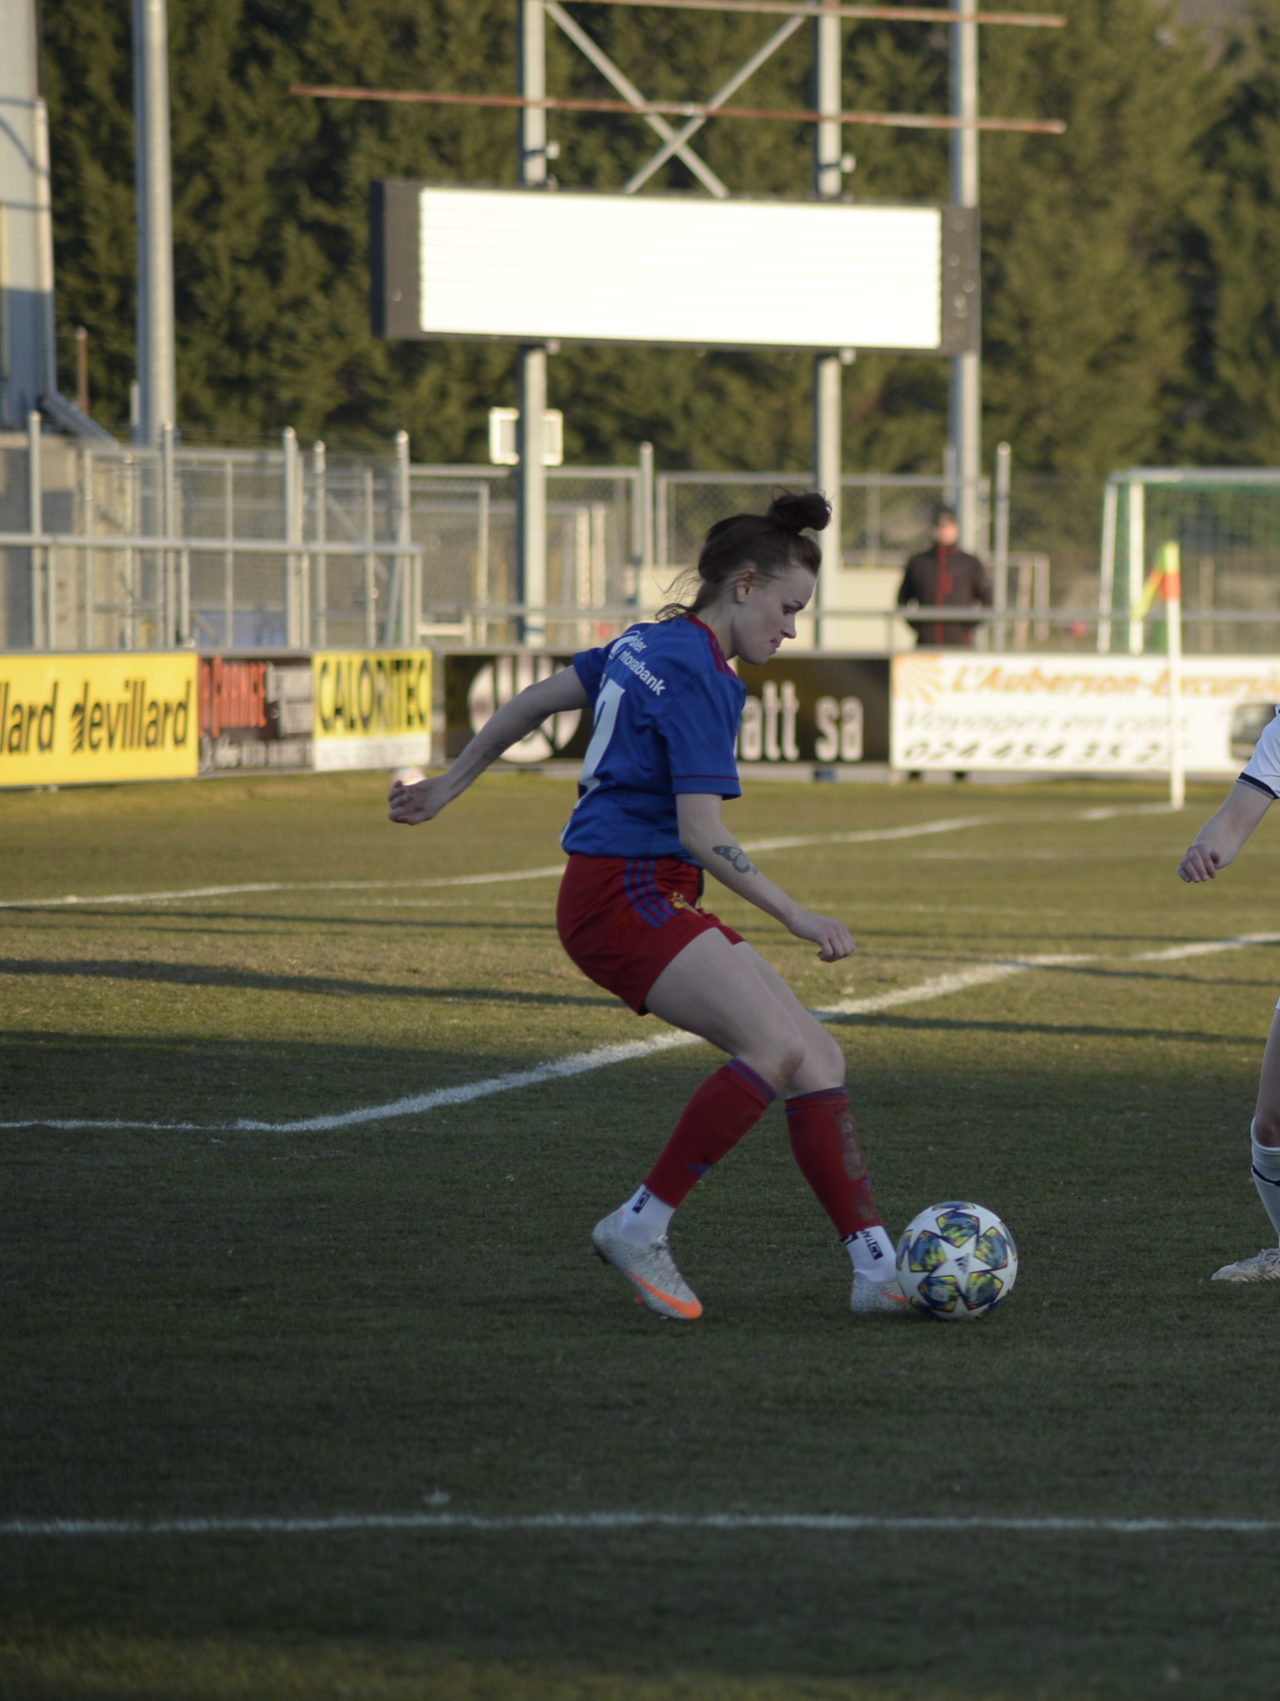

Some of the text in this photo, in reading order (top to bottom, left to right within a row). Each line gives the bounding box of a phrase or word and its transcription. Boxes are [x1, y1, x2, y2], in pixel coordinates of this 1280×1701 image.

[0, 680, 58, 754] lard
[71, 679, 193, 753] devillard
[735, 680, 863, 761] att sa
